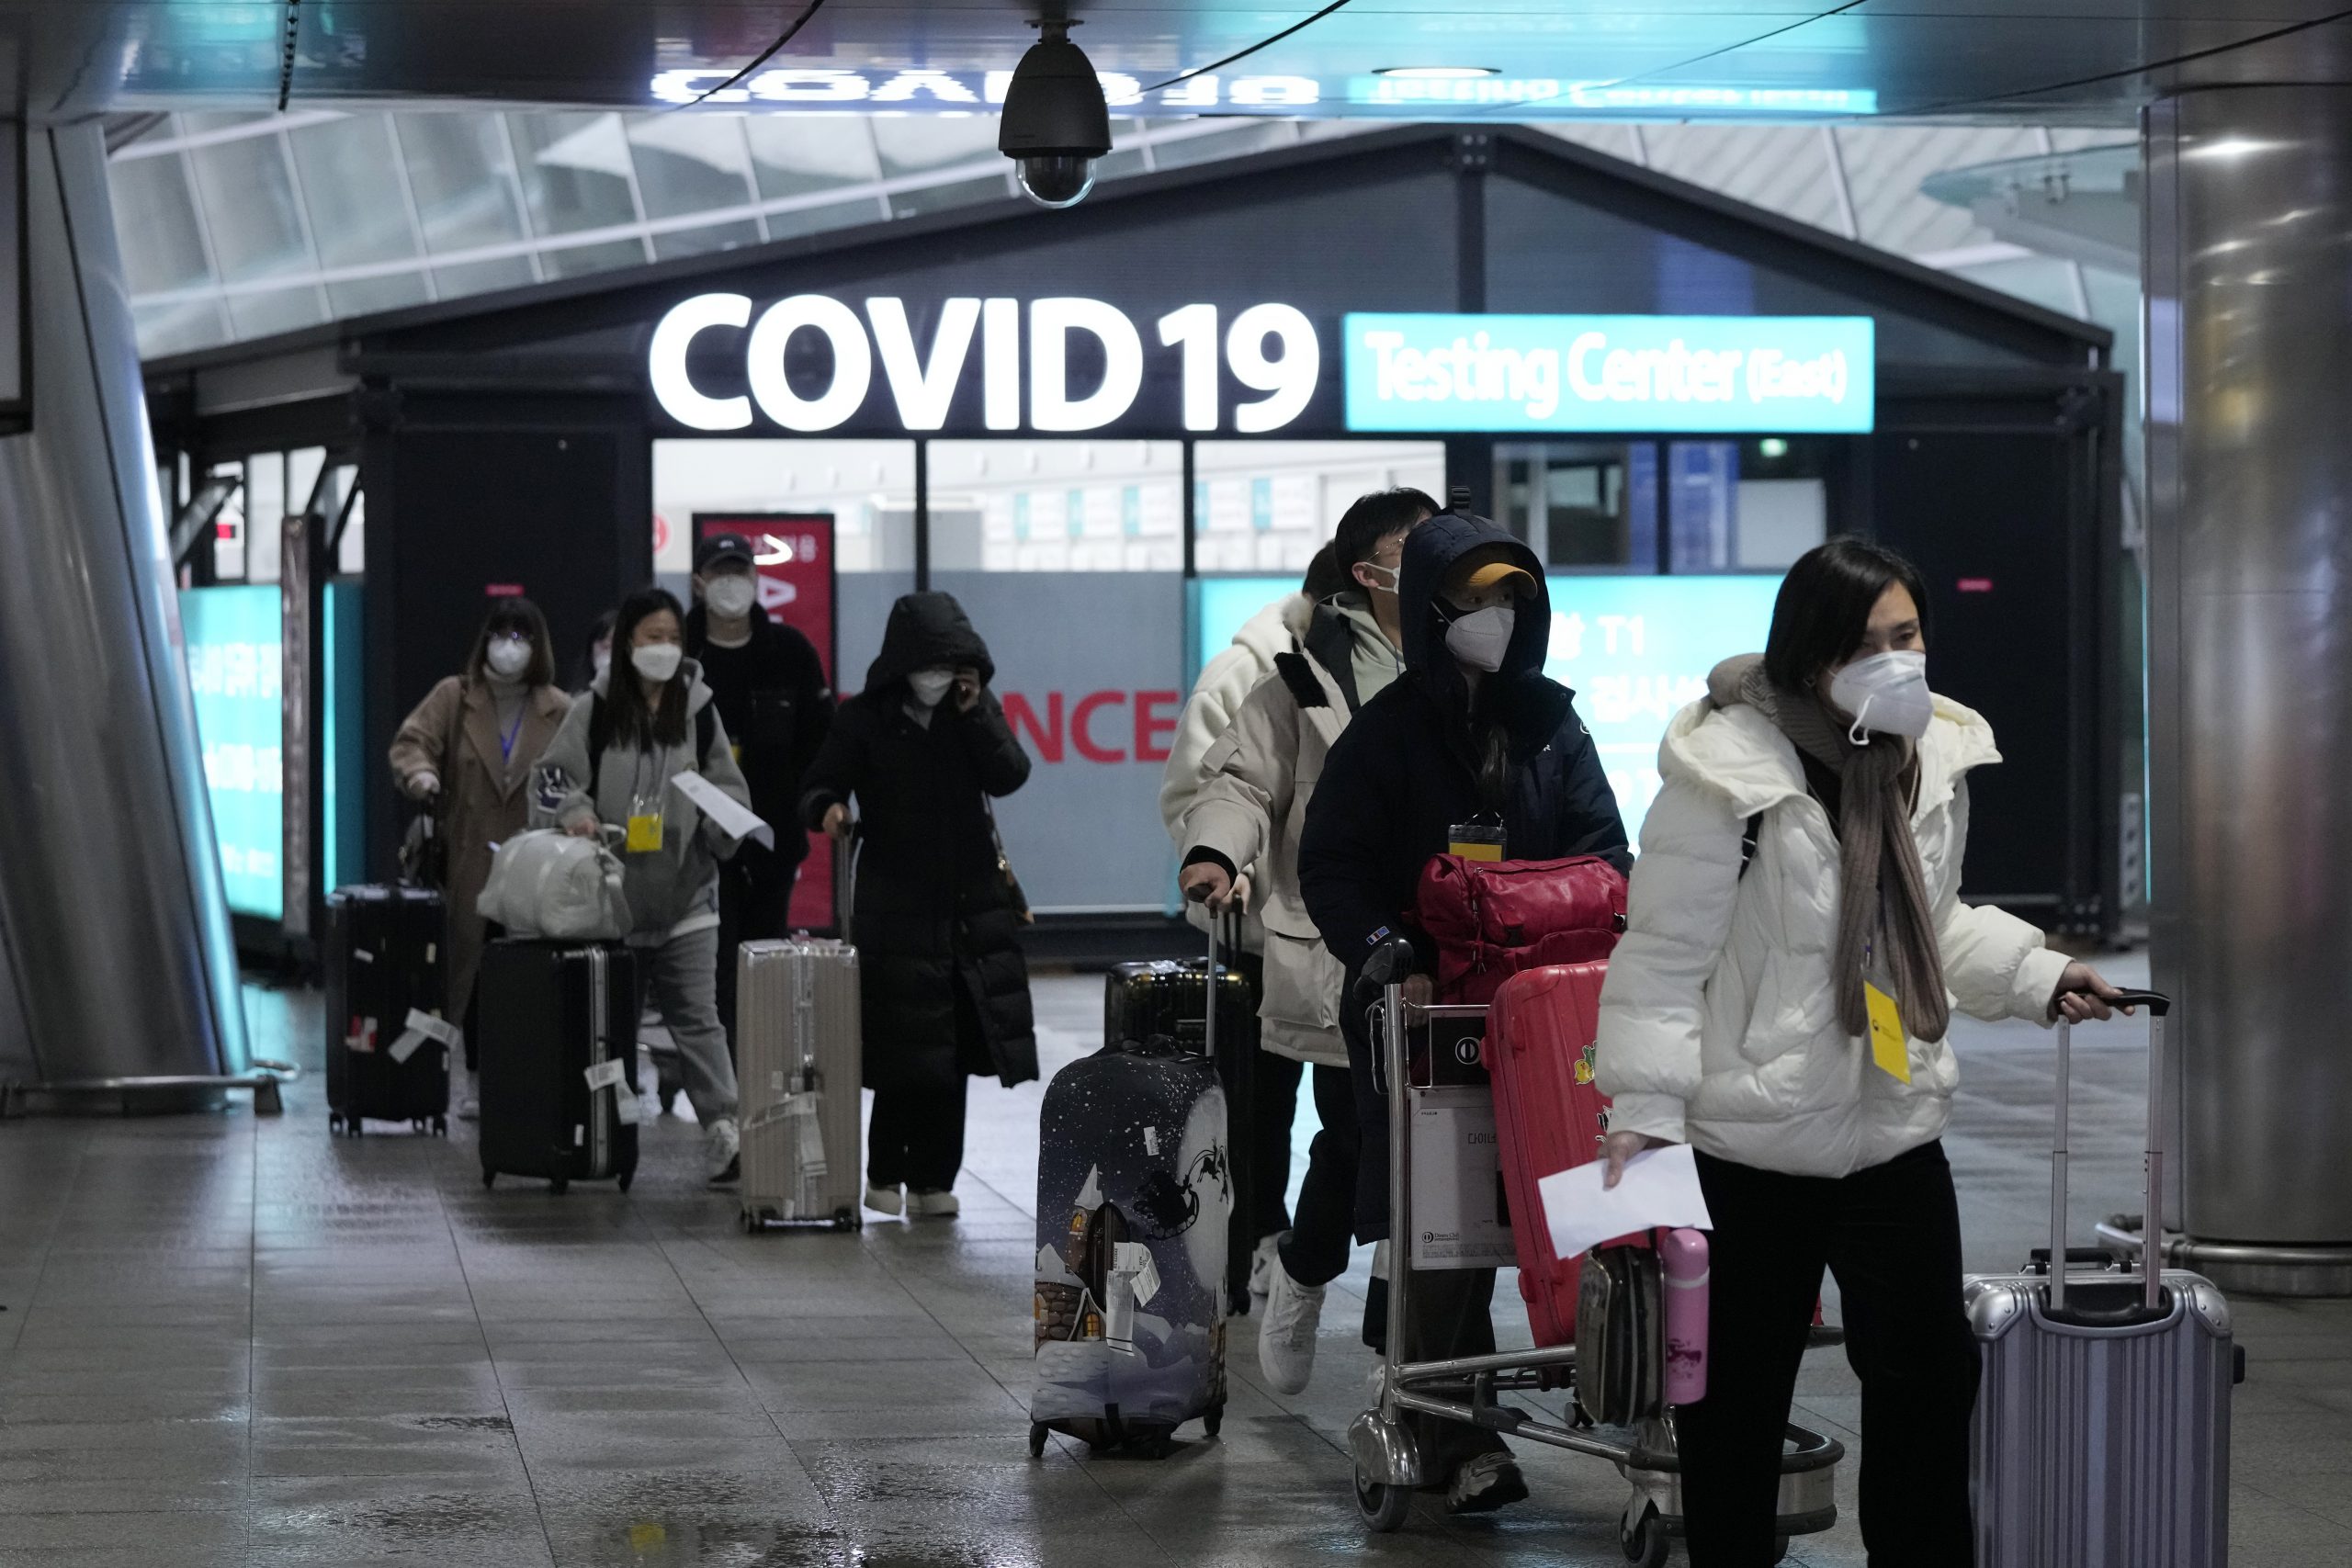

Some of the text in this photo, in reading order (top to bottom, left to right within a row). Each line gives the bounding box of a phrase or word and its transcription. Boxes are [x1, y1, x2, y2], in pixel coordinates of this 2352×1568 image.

[649, 293, 1848, 433] COVID 19 Testing Center (East)
[1597, 615, 1645, 657] T1
